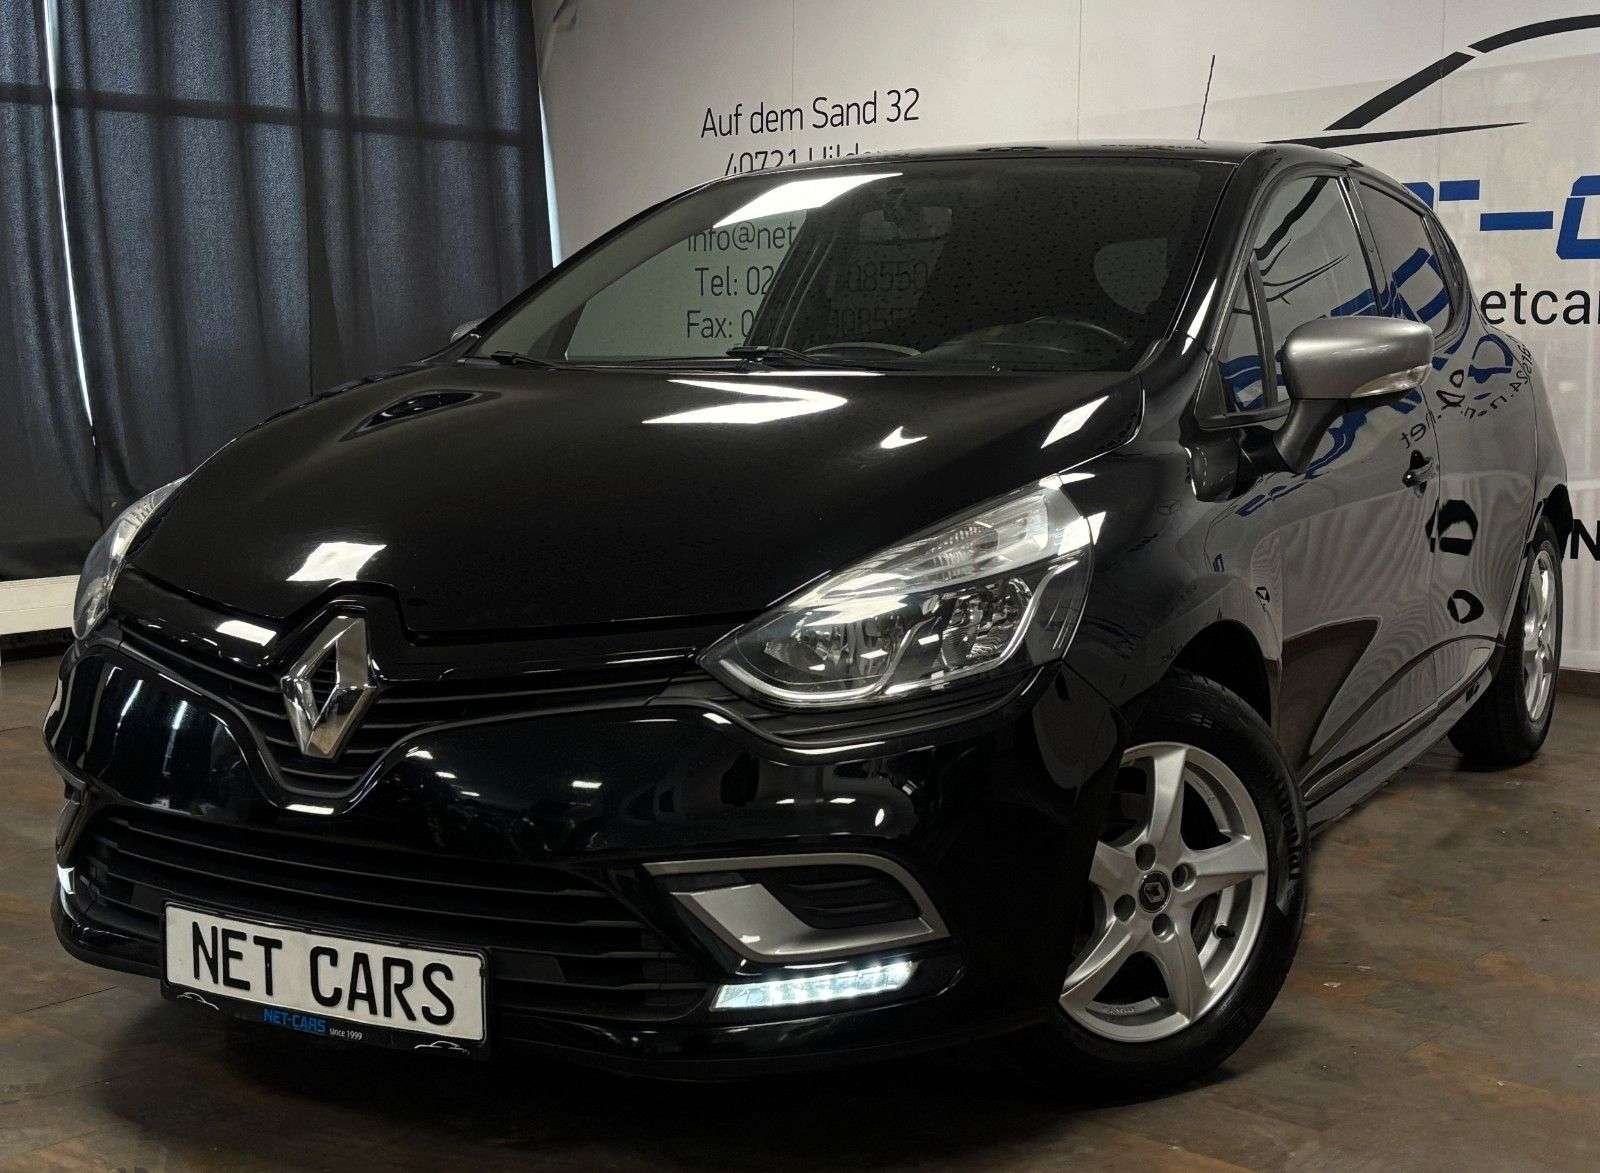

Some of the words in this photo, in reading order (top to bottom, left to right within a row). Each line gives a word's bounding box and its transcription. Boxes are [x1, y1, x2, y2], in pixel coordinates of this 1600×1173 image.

[701, 103, 743, 138] Auf
[750, 102, 803, 134] dem
[812, 90, 877, 129] Sand
[886, 87, 920, 123] 32
[694, 265, 738, 297] Tel:
[1481, 283, 1600, 325] etca
[686, 310, 732, 339] Fax:
[192, 921, 283, 997] NET
[309, 945, 455, 1026] CARS
[264, 1009, 326, 1034] NET-CARS
[346, 1030, 363, 1040] 1999
